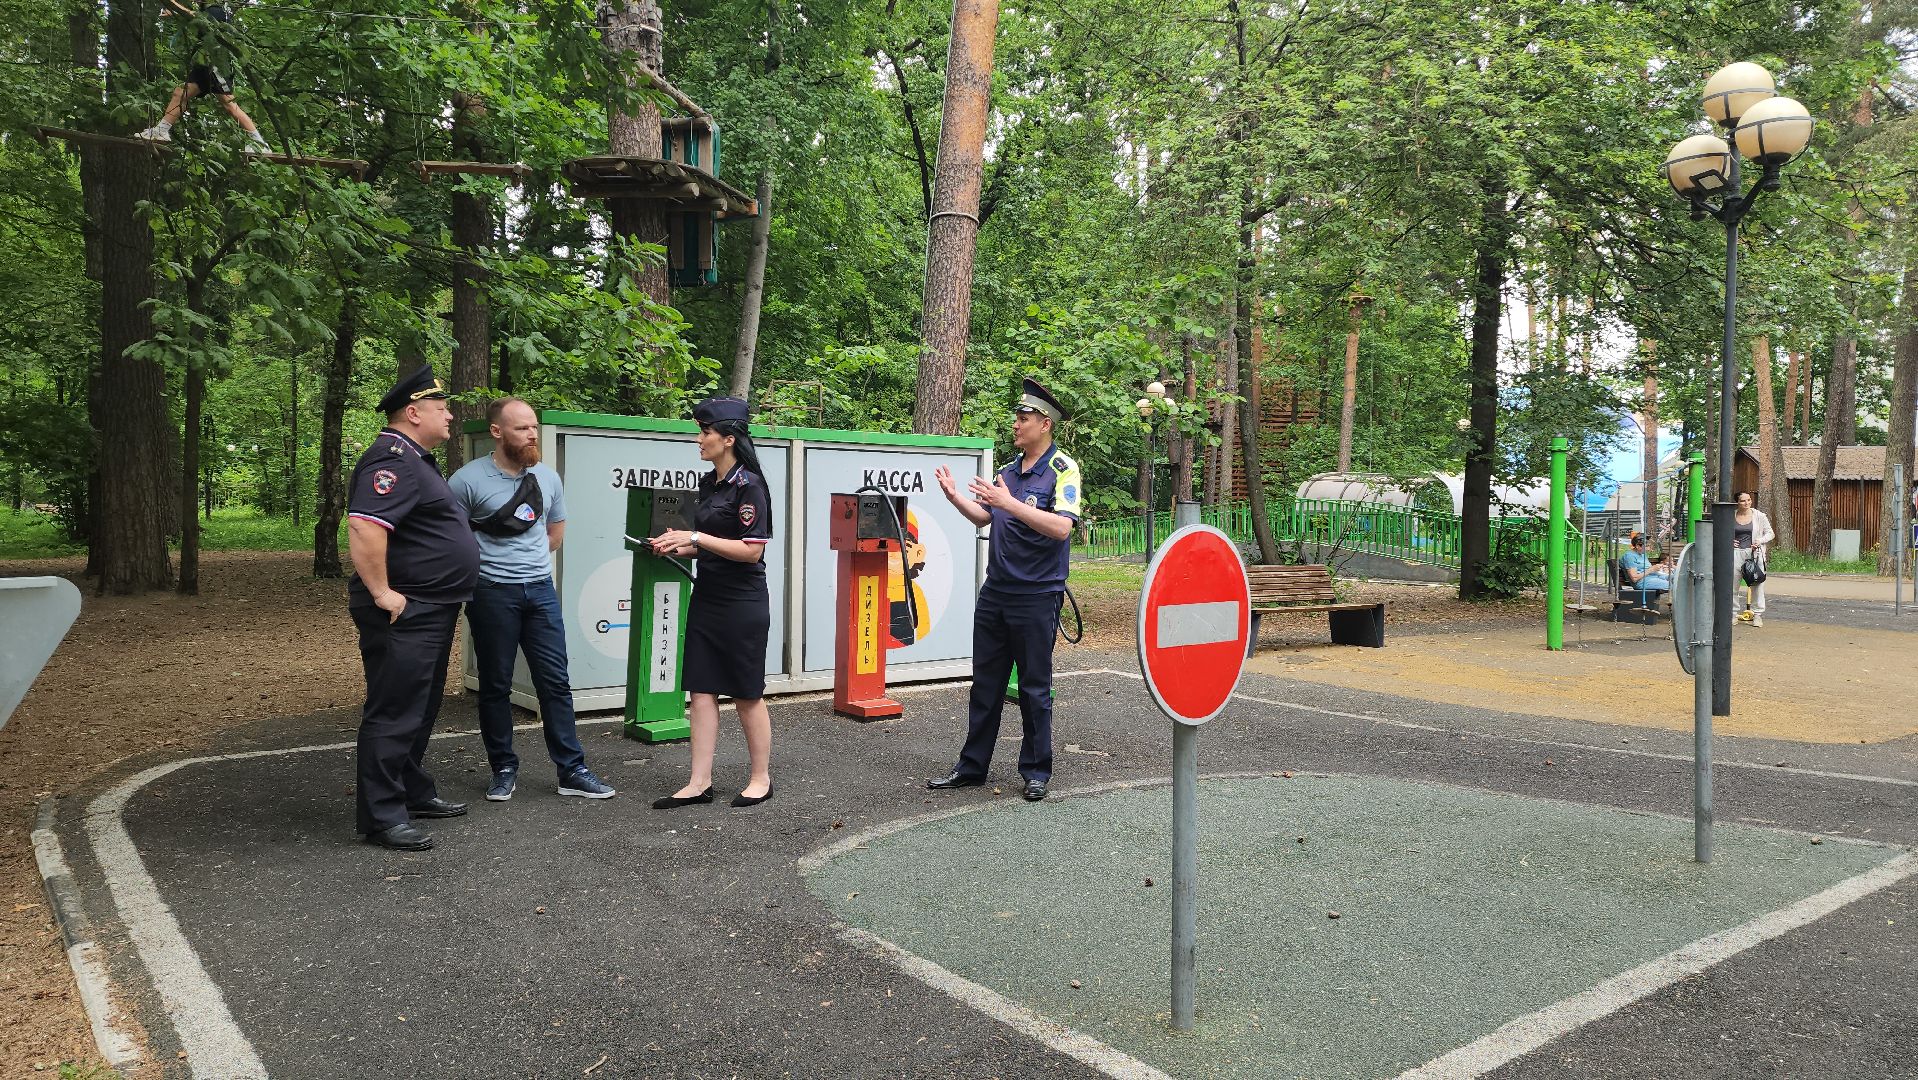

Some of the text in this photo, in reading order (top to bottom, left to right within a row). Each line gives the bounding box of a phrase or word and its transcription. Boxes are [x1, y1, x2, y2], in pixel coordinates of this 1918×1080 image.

[863, 469, 924, 492] КАССА
[659, 593, 669, 681] БЕНЗИН
[864, 585, 872, 665] ДИЗЕЛЬ
